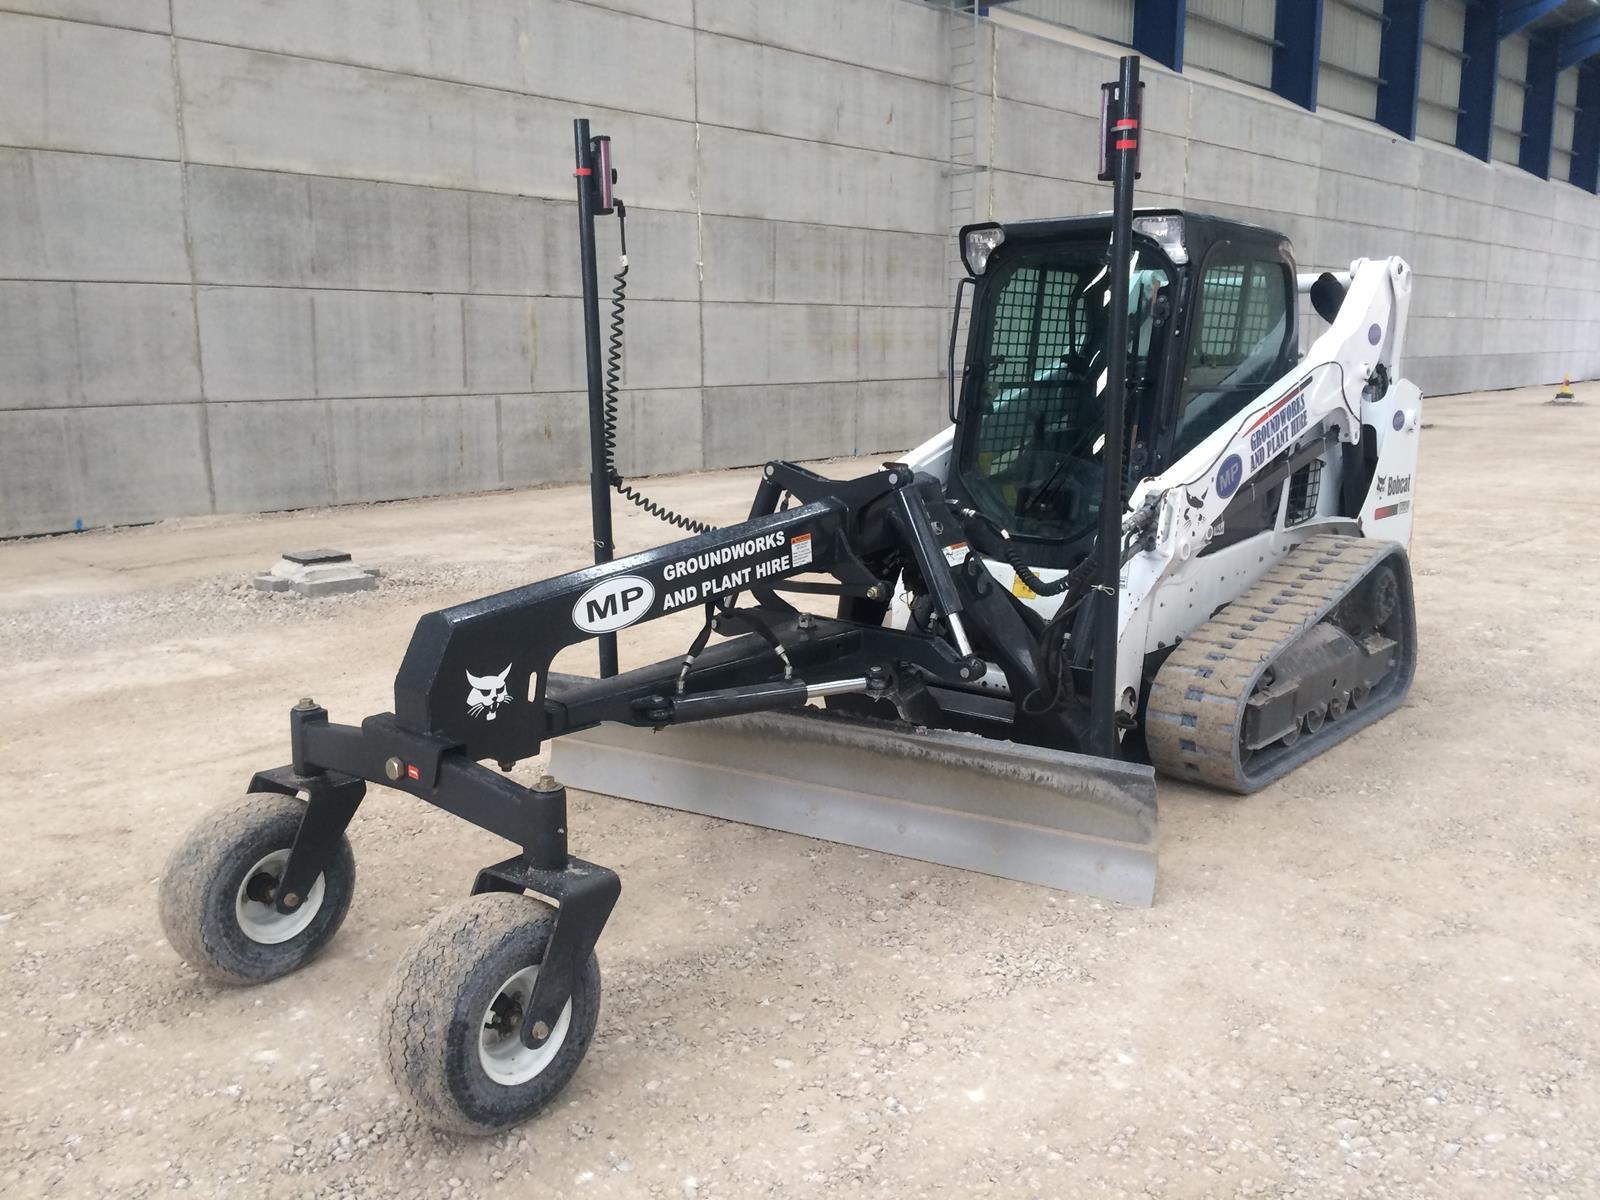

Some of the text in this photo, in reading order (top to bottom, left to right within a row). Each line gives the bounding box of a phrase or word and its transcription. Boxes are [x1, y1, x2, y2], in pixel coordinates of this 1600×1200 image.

[1250, 393, 1305, 452] GROUNDWORKS
[1250, 410, 1307, 473] AND PLANT HIRE
[1220, 463, 1239, 492] MP
[1388, 473, 1411, 496] Bobcat
[663, 530, 786, 581] GROUNDWORKS
[586, 586, 644, 623] MP
[663, 555, 791, 611] AND PLANT HIRE
